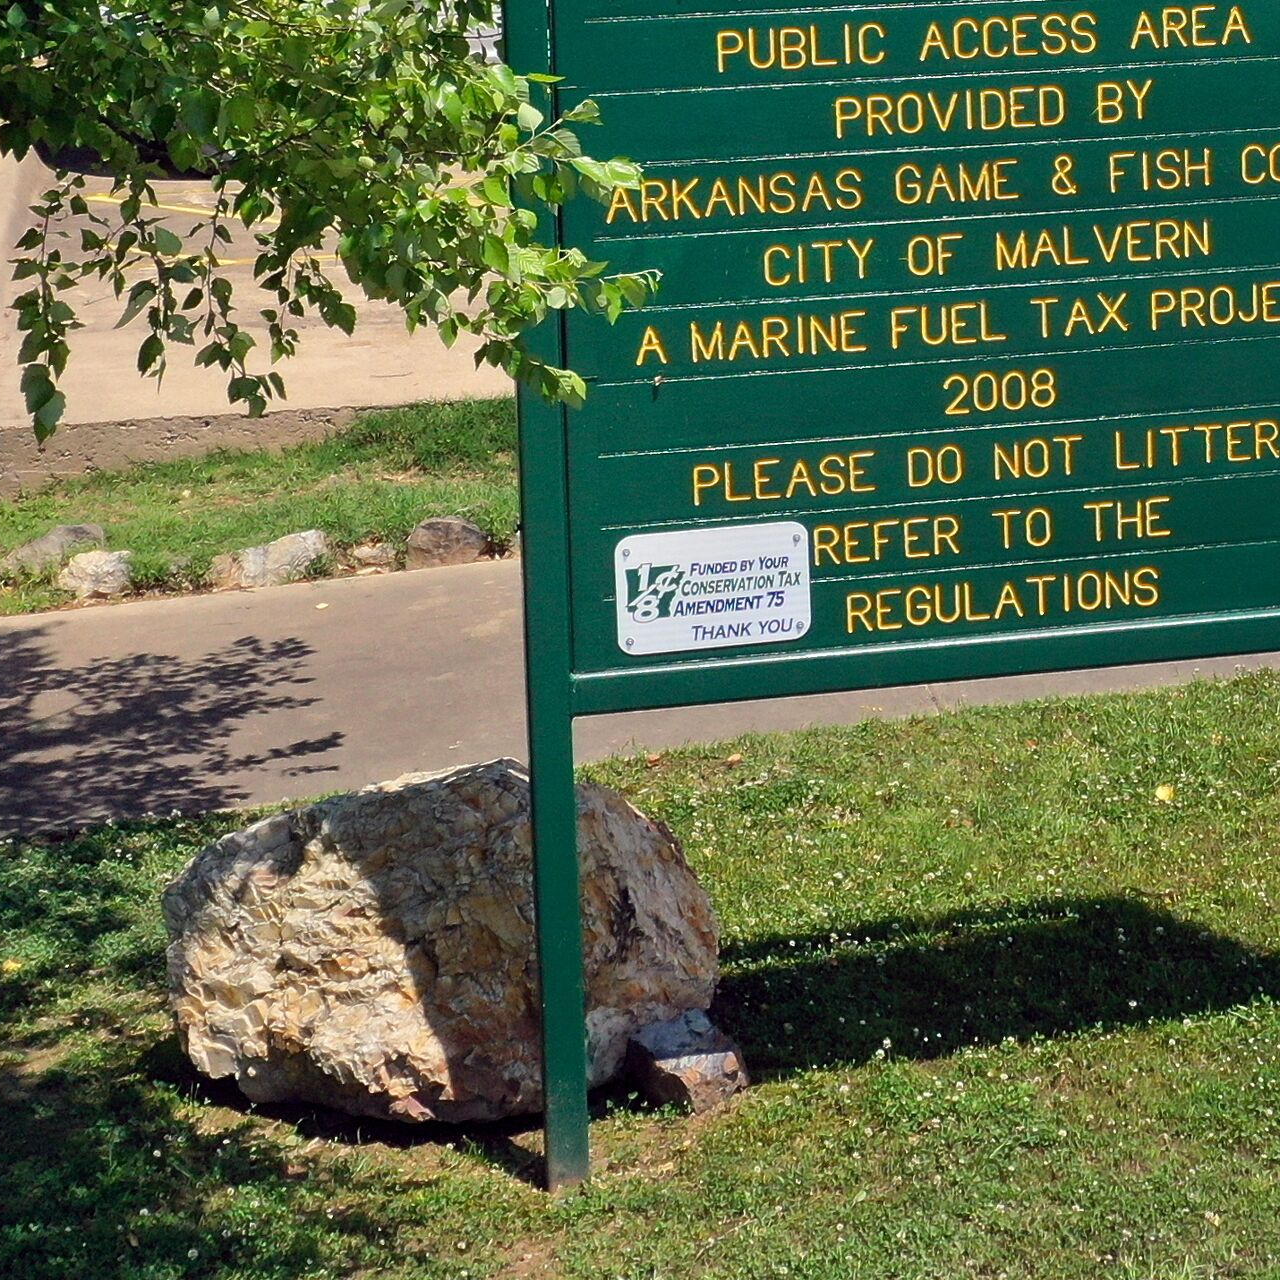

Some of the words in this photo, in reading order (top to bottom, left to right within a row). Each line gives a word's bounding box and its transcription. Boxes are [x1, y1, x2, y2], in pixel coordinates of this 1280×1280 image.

[716, 23, 886, 72] PUBLIC
[919, 12, 1098, 61] ACCESS
[1130, 4, 1252, 49] AREA
[834, 84, 1066, 138] PROVIDED
[1095, 79, 1154, 124] BY
[606, 168, 863, 224] ARKANSAS
[894, 158, 1020, 205] GAME
[1051, 155, 1077, 195] &
[1108, 148, 1212, 193] FISH
[763, 238, 875, 287] CITY
[906, 232, 964, 276] OF
[994, 219, 1211, 271] MALVERN
[635, 326, 668, 366] A
[690, 310, 868, 363] MARINE
[890, 301, 1007, 349] FUEL
[1030, 292, 1130, 339] TAX
[943, 367, 1058, 416] 2008
[692, 450, 876, 507] PLEASE
[907, 443, 964, 489] DO
[993, 434, 1083, 480] NOT
[1114, 419, 1280, 470] LITTER
[813, 514, 961, 567] REFER
[993, 507, 1053, 549] TO
[1083, 495, 1172, 542] THE
[673, 595, 763, 618] AMENDMENT
[766, 591, 785, 608] 75
[681, 574, 774, 597] CONSERVATION
[778, 571, 801, 587] TAX
[846, 566, 1159, 634] REGULATIONS
[691, 622, 752, 641] THANK
[758, 618, 793, 635] YOU
